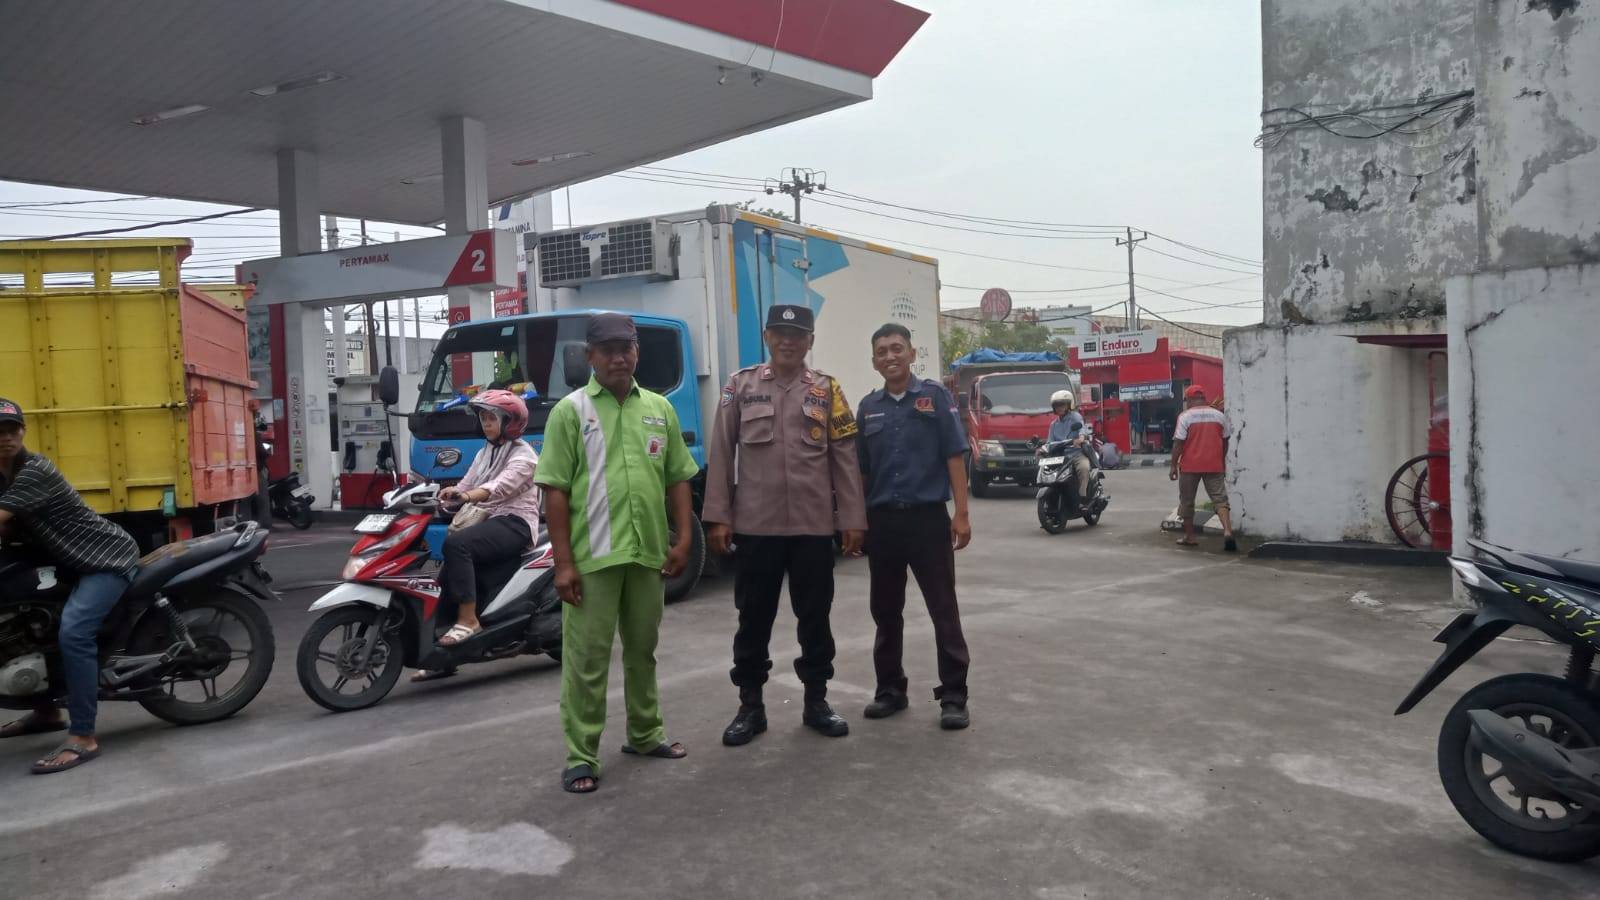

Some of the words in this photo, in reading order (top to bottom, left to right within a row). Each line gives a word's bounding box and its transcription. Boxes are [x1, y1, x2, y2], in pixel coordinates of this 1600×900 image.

[582, 231, 607, 242] Topre
[339, 253, 390, 268] PERTAMAX
[471, 249, 485, 273] 2
[1101, 339, 1140, 351] Enduro
